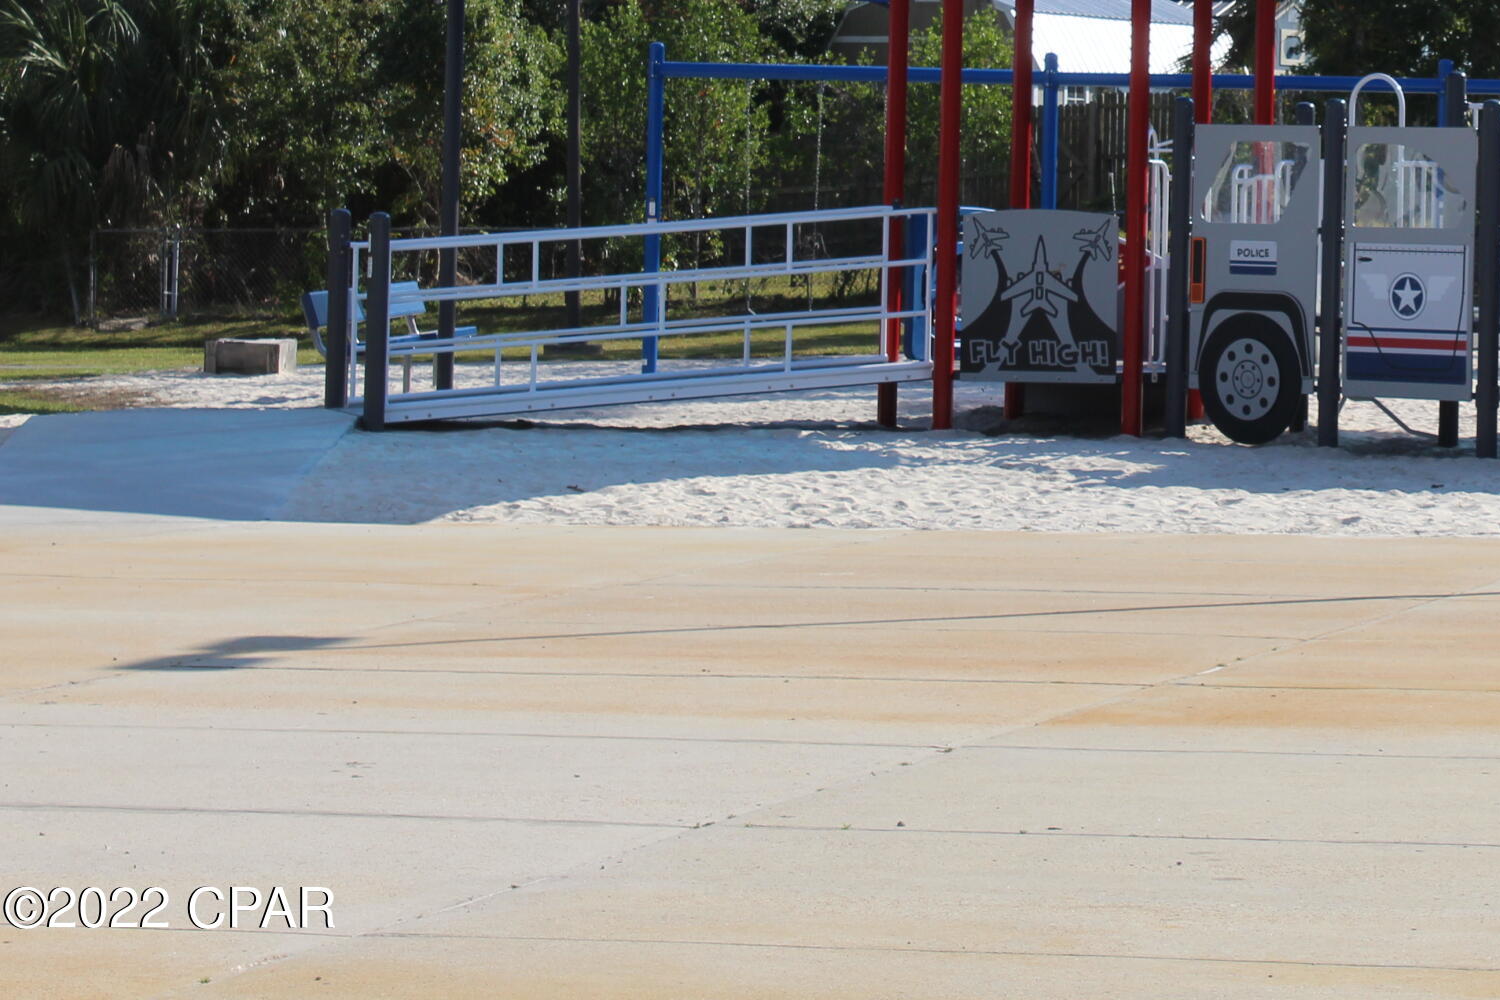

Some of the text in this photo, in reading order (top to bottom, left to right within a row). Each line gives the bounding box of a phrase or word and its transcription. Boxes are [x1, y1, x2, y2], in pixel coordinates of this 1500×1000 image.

[1237, 248, 1270, 258] POLICE
[969, 338, 1109, 367] FLY HIGH!
